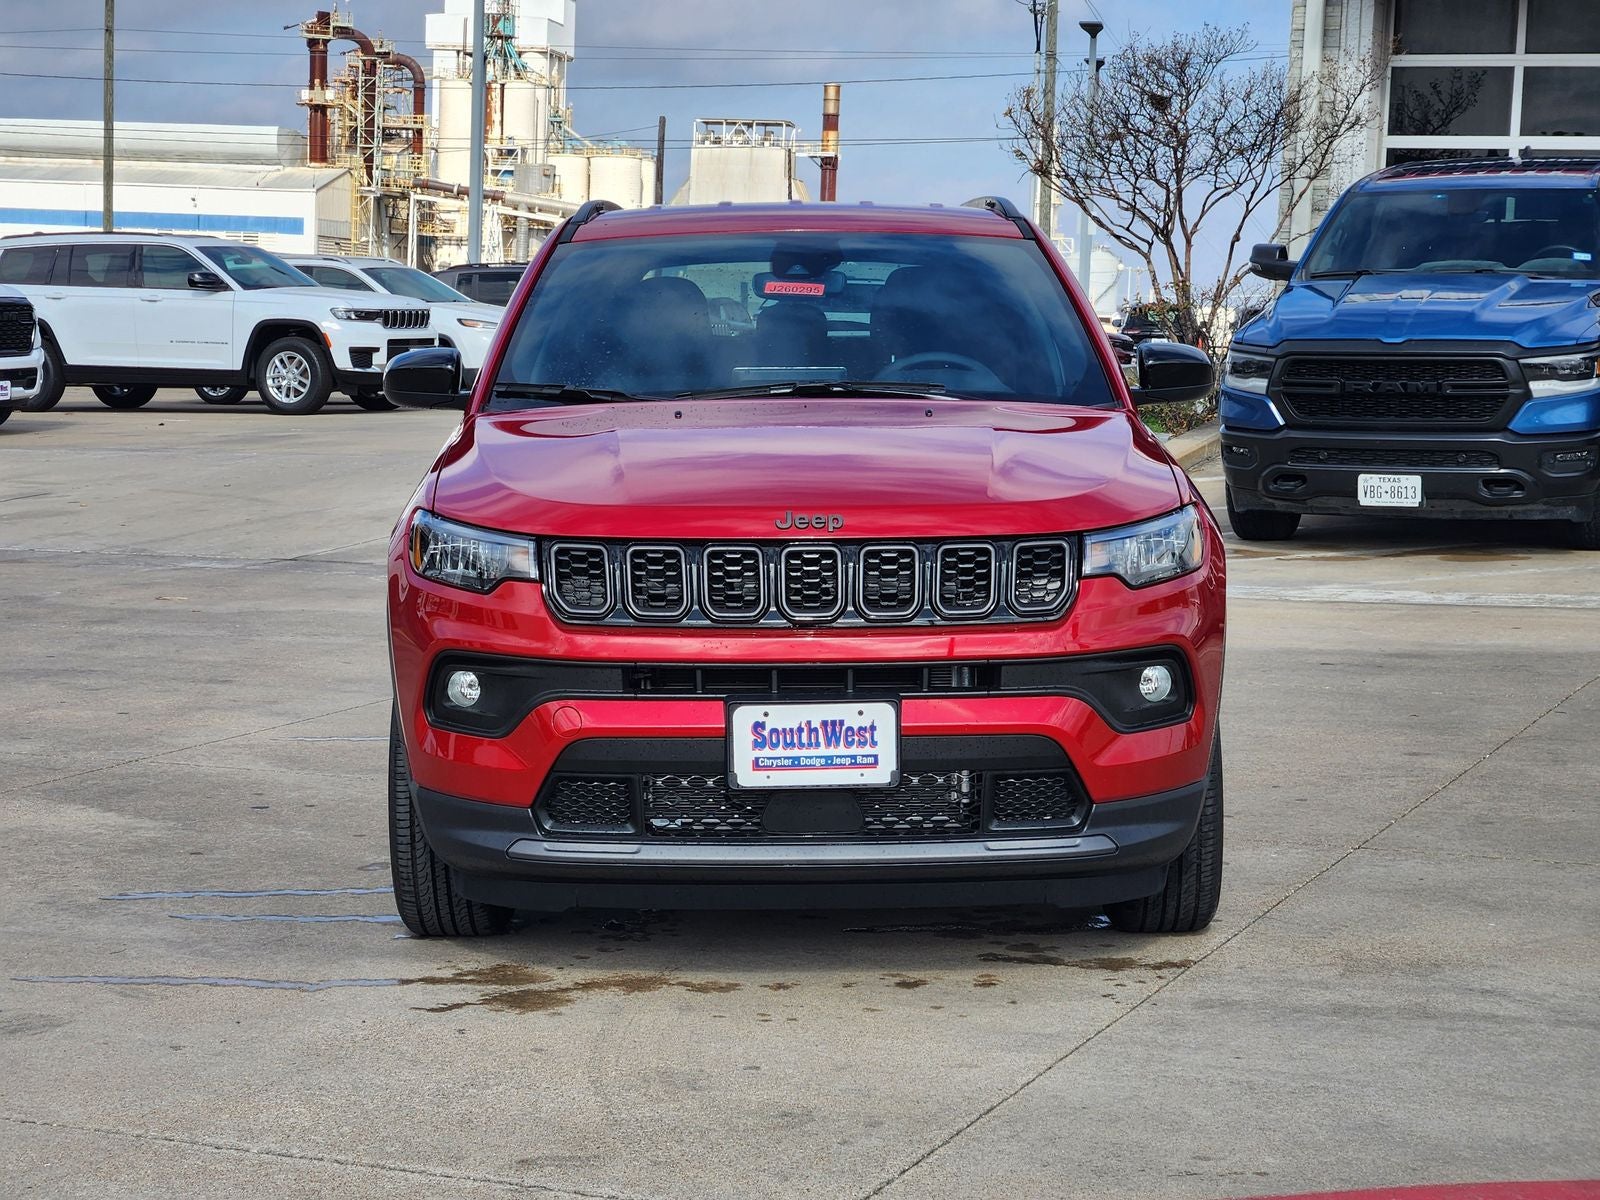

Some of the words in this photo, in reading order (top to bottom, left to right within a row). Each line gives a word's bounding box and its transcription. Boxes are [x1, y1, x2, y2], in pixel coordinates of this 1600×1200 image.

[1343, 380, 1439, 393] RAM
[774, 510, 844, 532] Jeep
[751, 719, 878, 750] SouthWest
[758, 757, 793, 767] Chrysler
[800, 756, 825, 766] Dodge
[832, 756, 851, 766] Jeep
[856, 755, 875, 764] Ram
